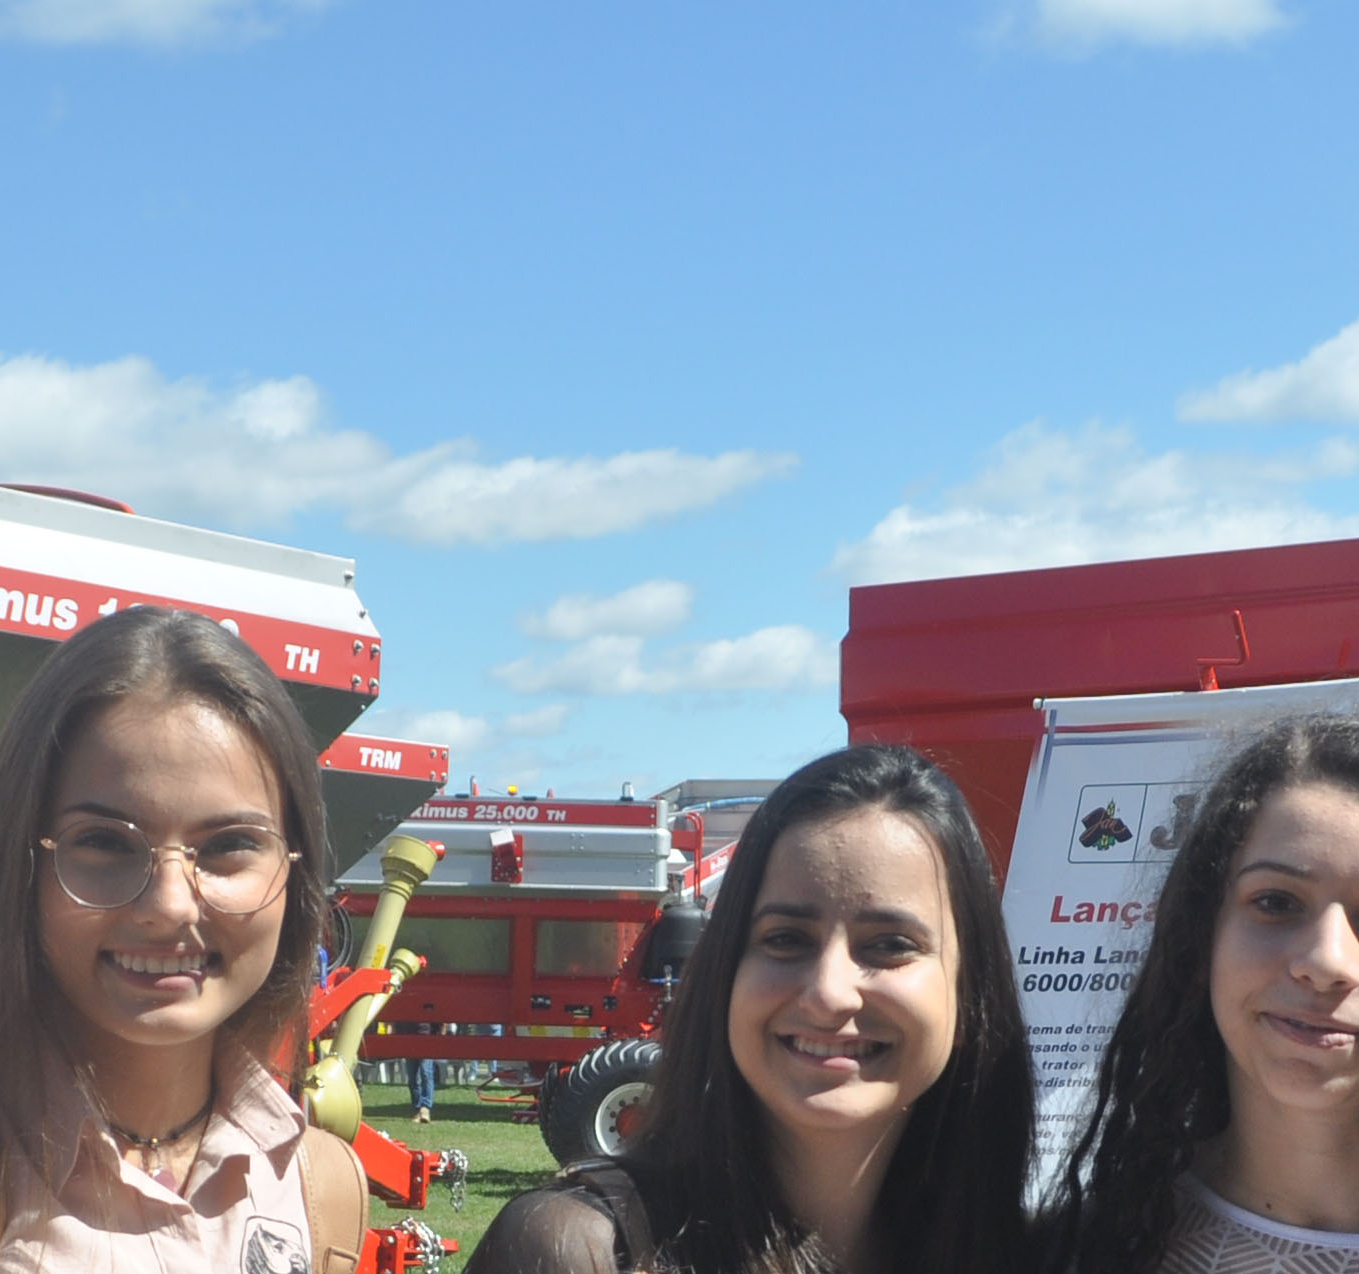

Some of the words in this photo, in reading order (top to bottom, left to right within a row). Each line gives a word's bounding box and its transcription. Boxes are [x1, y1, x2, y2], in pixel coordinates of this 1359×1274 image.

[284, 643, 320, 674] TH
[359, 747, 402, 771] TRM
[410, 803, 468, 820] ximus
[474, 805, 539, 821] 25.000
[546, 809, 566, 821] TH
[1018, 946, 1085, 965] Linha
[1065, 1024, 1083, 1035] de
